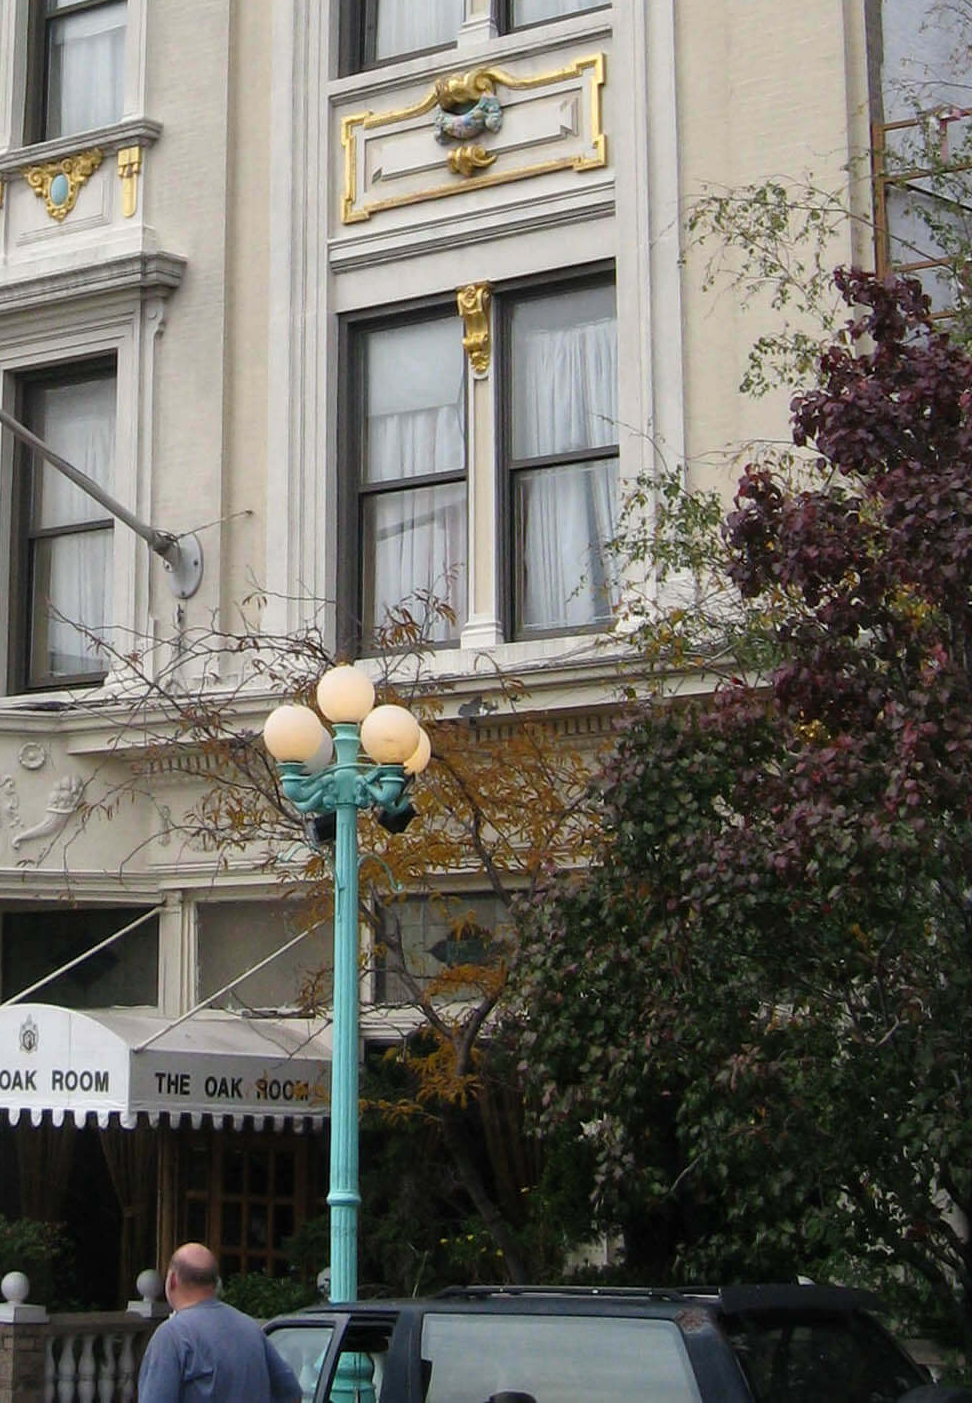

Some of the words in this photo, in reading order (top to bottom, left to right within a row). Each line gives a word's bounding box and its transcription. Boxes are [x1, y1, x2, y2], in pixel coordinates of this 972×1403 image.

[51, 1070, 110, 1093] ROOM
[154, 1072, 191, 1096] THE
[204, 1075, 244, 1099] OAK
